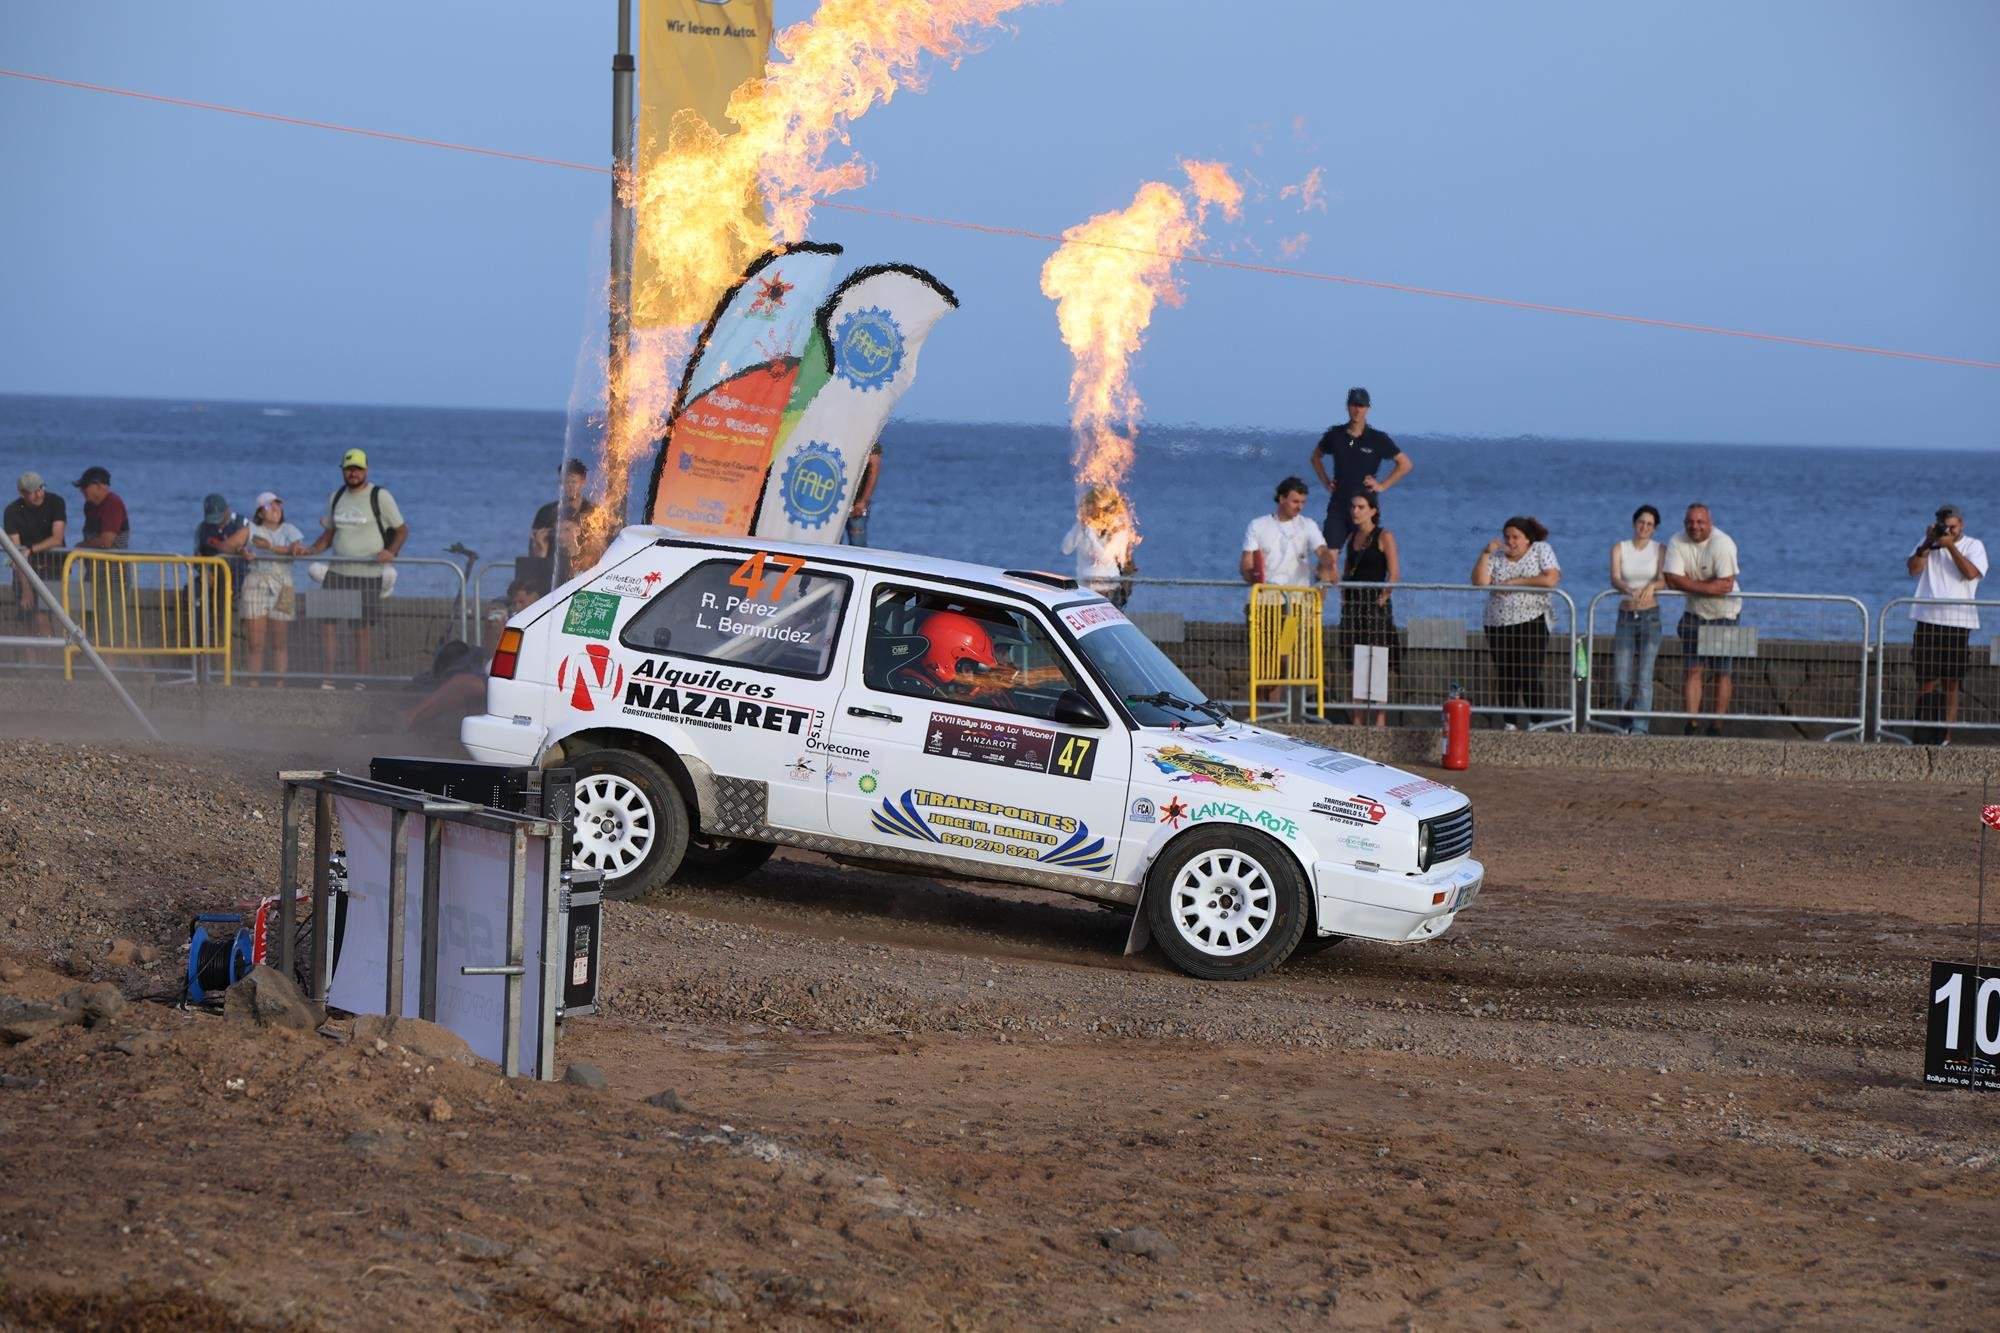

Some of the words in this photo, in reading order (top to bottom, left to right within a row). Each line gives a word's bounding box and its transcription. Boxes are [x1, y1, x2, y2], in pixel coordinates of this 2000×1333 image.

[666, 19, 685, 32] Wir
[729, 551, 807, 602] 47
[701, 592, 719, 610] R.
[726, 596, 778, 618] Pérez
[696, 613, 712, 630] L.
[718, 616, 811, 644] Bermúdez
[632, 659, 776, 699] Alquileres
[622, 706, 679, 724] Construcciones
[679, 717, 684, 725] y
[685, 717, 732, 732] Promociones
[624, 682, 809, 735] NAZARET
[932, 713, 956, 725] XXVII
[956, 718, 978, 729] Rallye
[995, 724, 1005, 732] de
[1007, 725, 1019, 735] Los
[1022, 728, 1053, 740] Volcanes
[806, 738, 870, 758] Orvecame
[960, 734, 1017, 750] LANZAROTE
[1057, 737, 1090, 775] 47
[914, 789, 1077, 833] TRANSPORTES
[1312, 802, 1331, 810] GRUAS
[1332, 806, 1357, 816] CURBELO
[1324, 797, 1363, 811] TRANSPORTES
[928, 813, 971, 830] JORGE
[973, 819, 990, 833] M.
[994, 825, 1057, 845] BARRETO
[1190, 801, 1300, 840] LANZAROTE
[941, 832, 974, 848] 620
[975, 838, 1004, 854] 279
[1006, 844, 1039, 860] 328
[1926, 1074, 1946, 1083] Rallye
[1944, 1063, 1996, 1075] LANZAROTE
